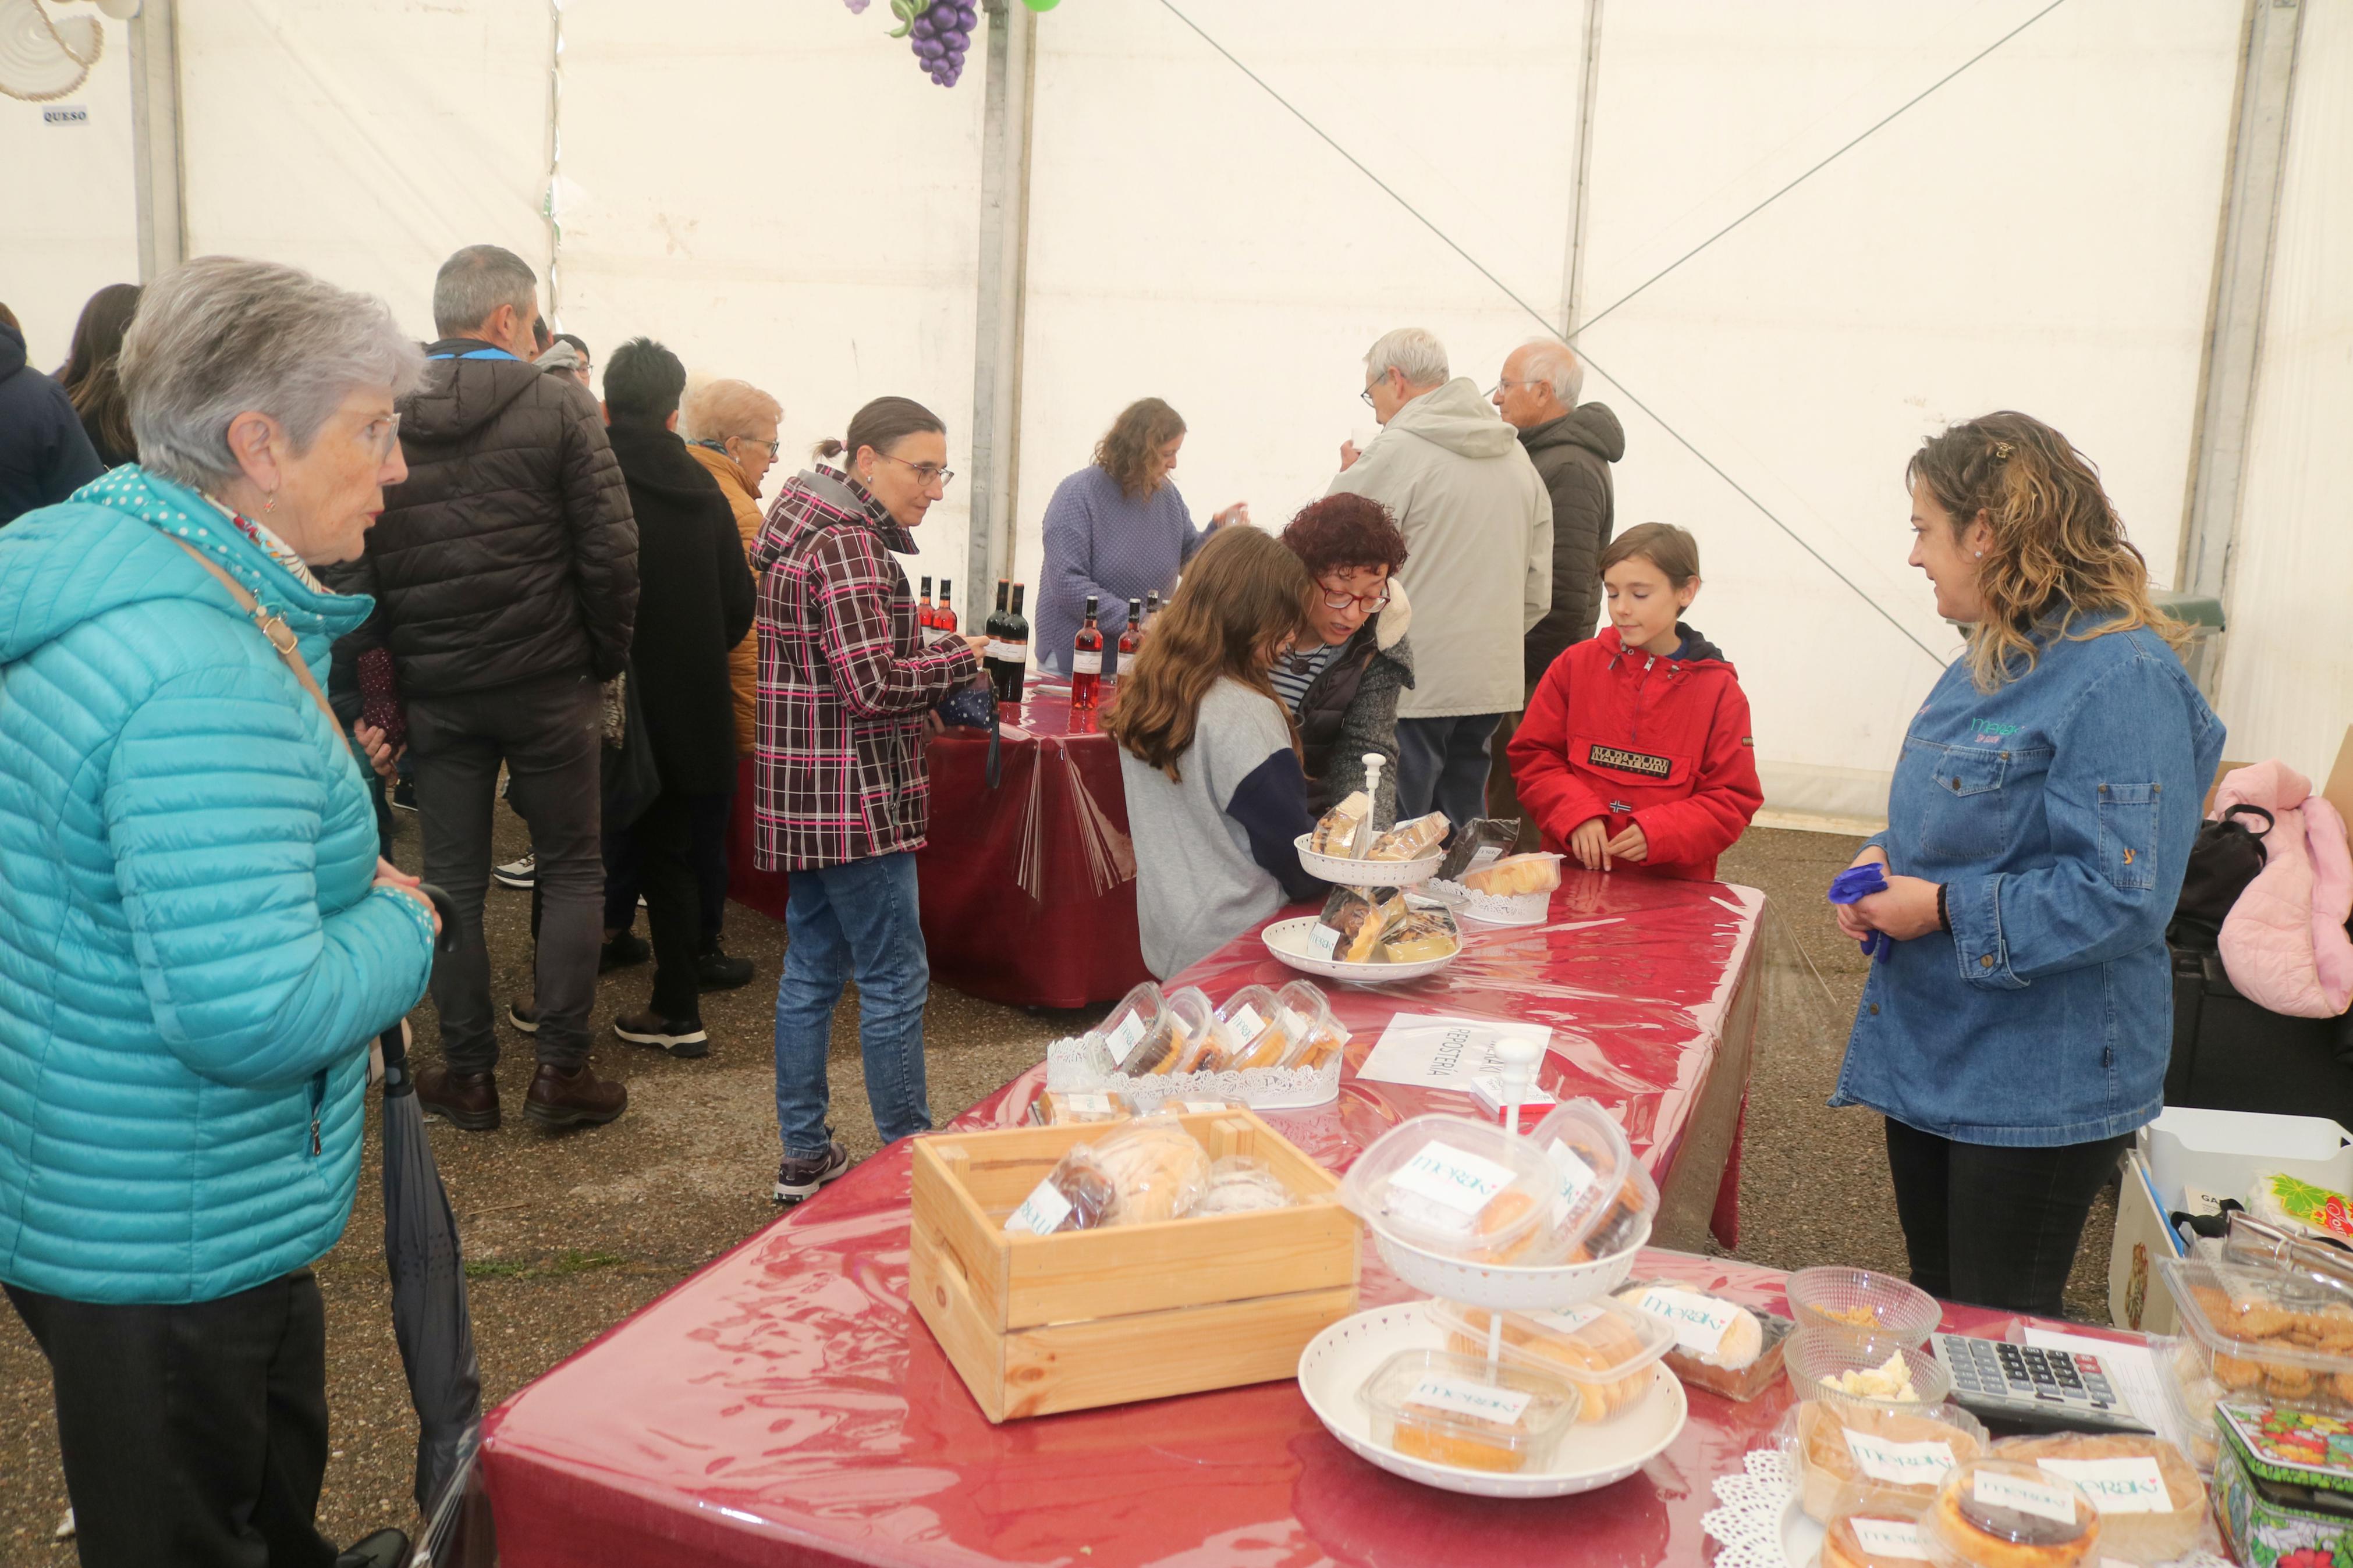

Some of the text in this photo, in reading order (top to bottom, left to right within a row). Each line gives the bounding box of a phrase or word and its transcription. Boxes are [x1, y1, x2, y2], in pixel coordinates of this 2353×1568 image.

[44, 111, 86, 122] QUESO
[1592, 746, 1668, 773] NAPAPIJRI
[1426, 1027, 1471, 1076] REPOSTERÍA
